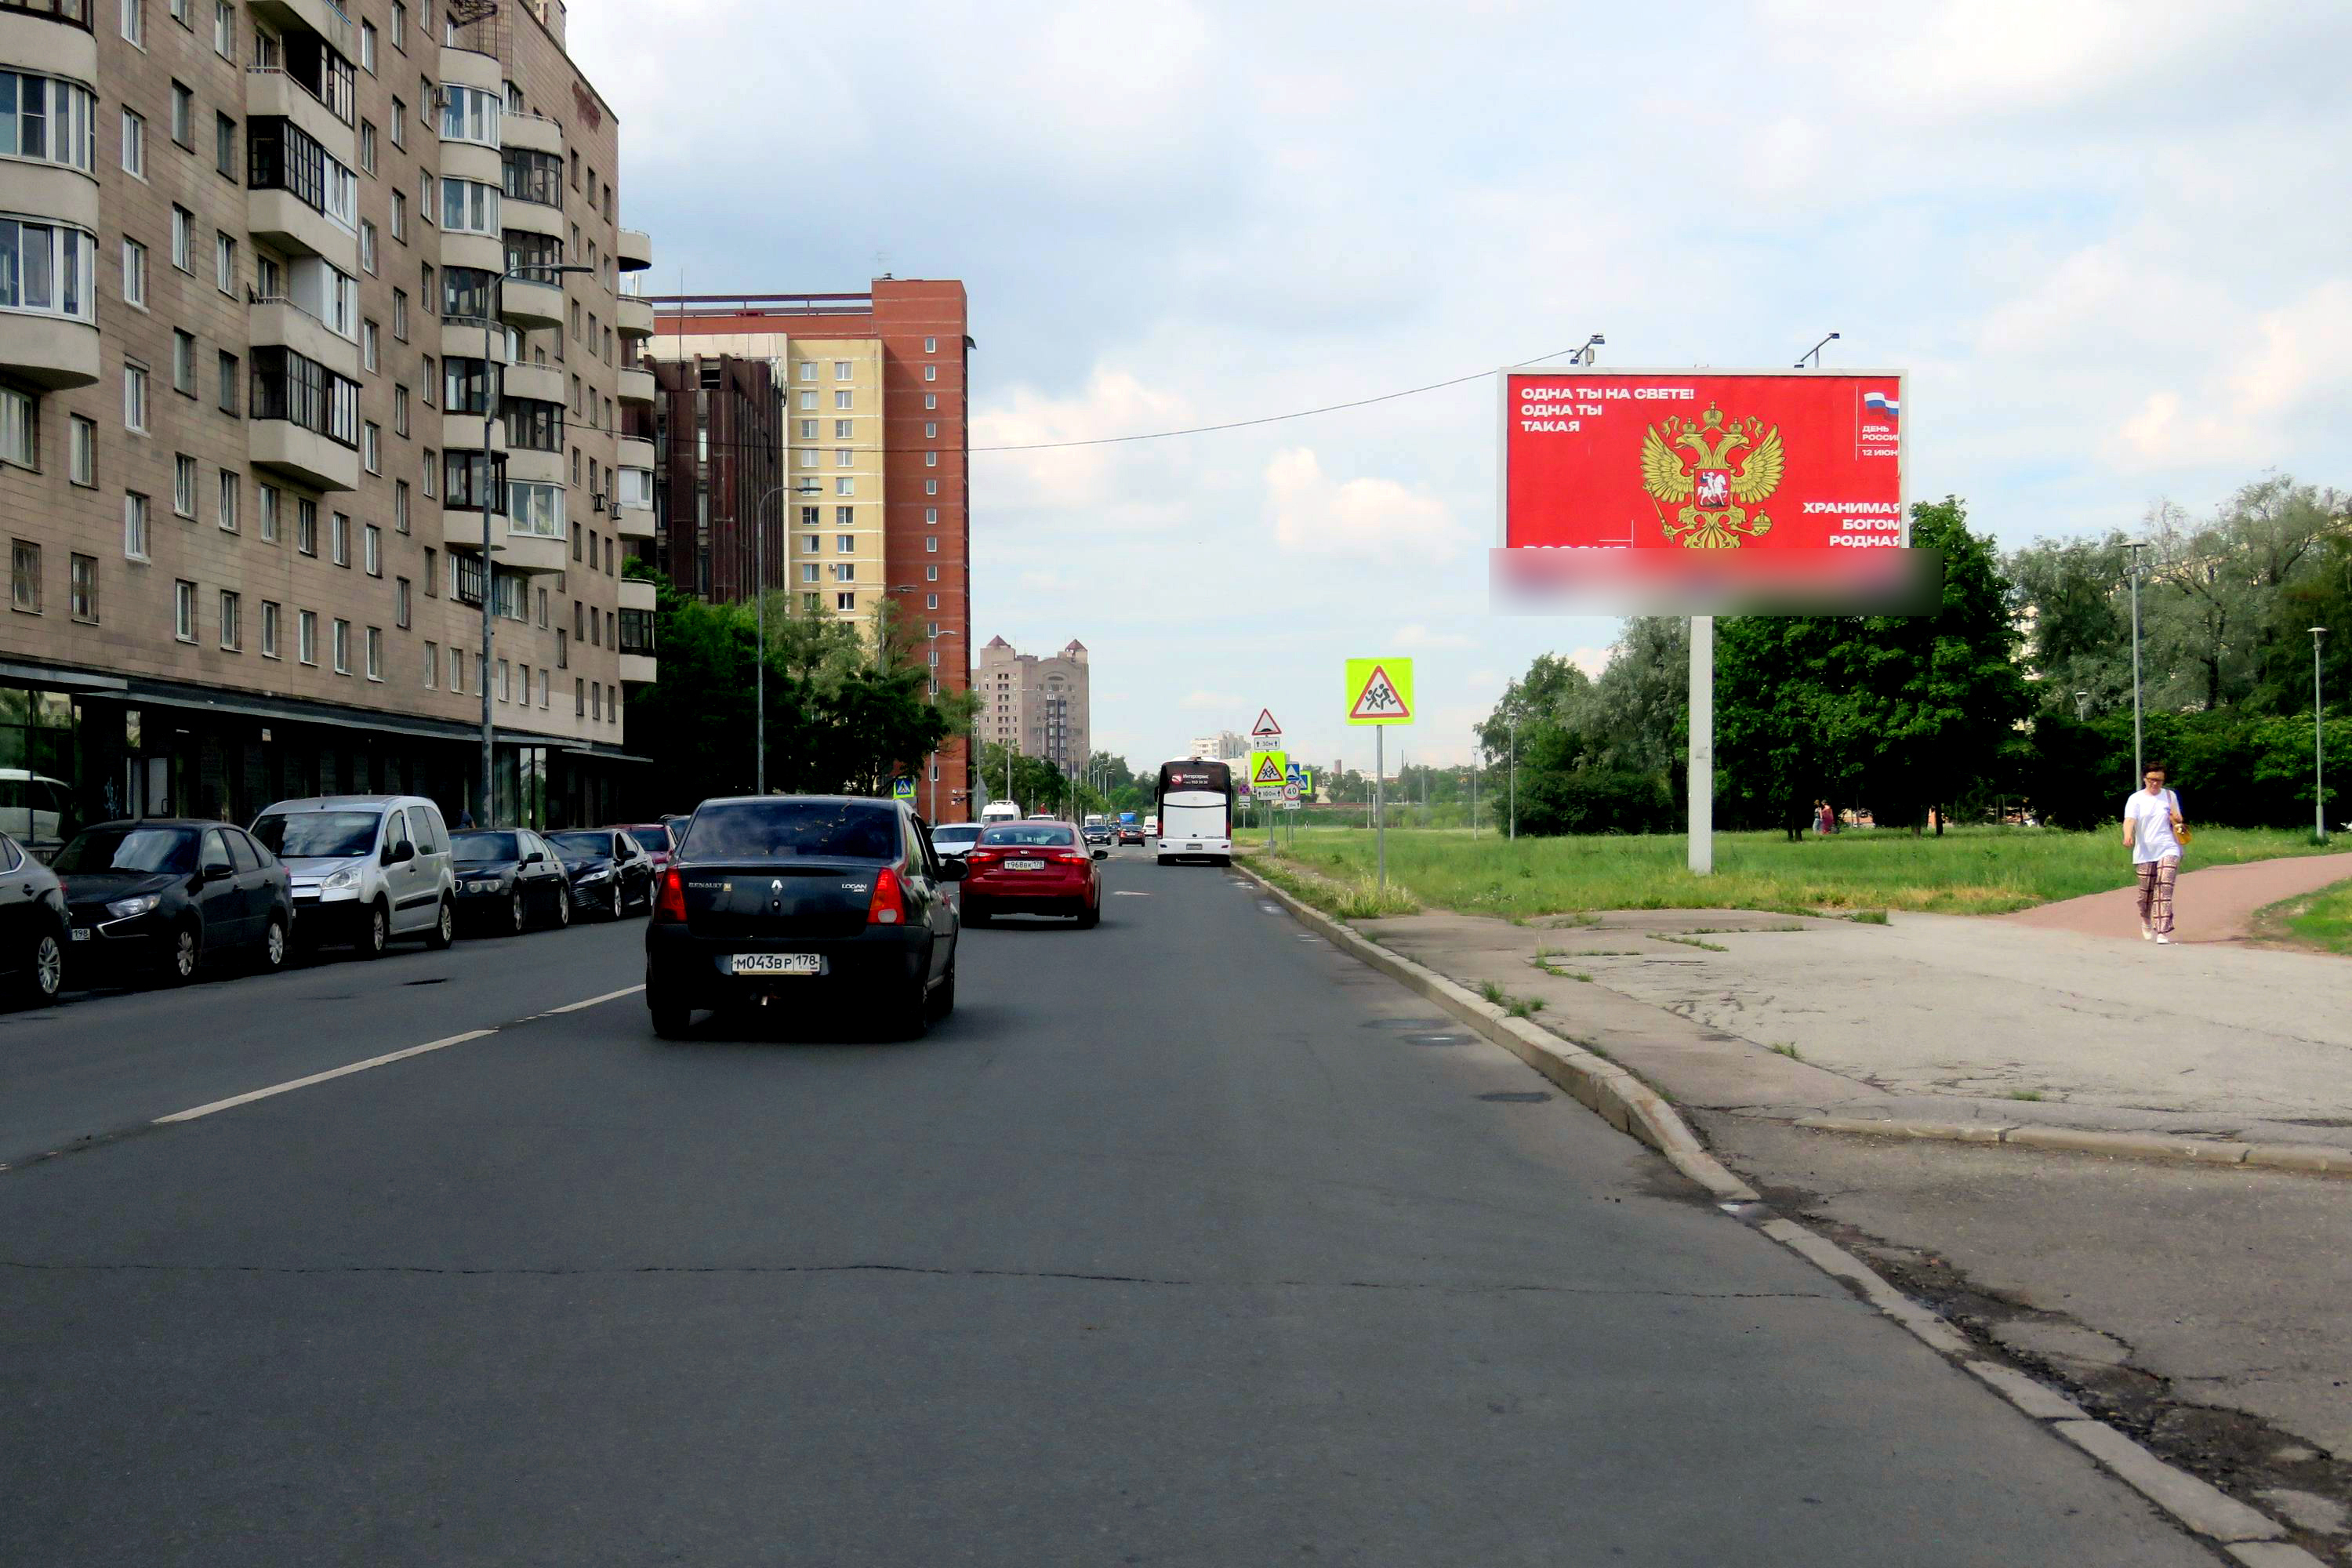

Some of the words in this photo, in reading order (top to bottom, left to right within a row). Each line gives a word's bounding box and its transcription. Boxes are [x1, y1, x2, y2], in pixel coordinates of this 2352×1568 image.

[1521, 388, 1573, 401] ОДНА
[1576, 388, 1602, 400] ТЫ
[1606, 388, 1631, 400] НА
[1634, 388, 1694, 400] СВЕТЕ!
[1521, 405, 1573, 417] ОДНА
[1576, 405, 1602, 416] ТЫ
[1521, 421, 1580, 432] ТАКАЯ
[1802, 502, 1900, 514] ХРАНИМАЯ
[1842, 519, 1900, 530] БОГОМ
[1829, 535, 1900, 548] РОДНАЯ
[74, 929, 89, 938] 198
[736, 956, 793, 969] М043ВР
[795, 955, 816, 966] 178
